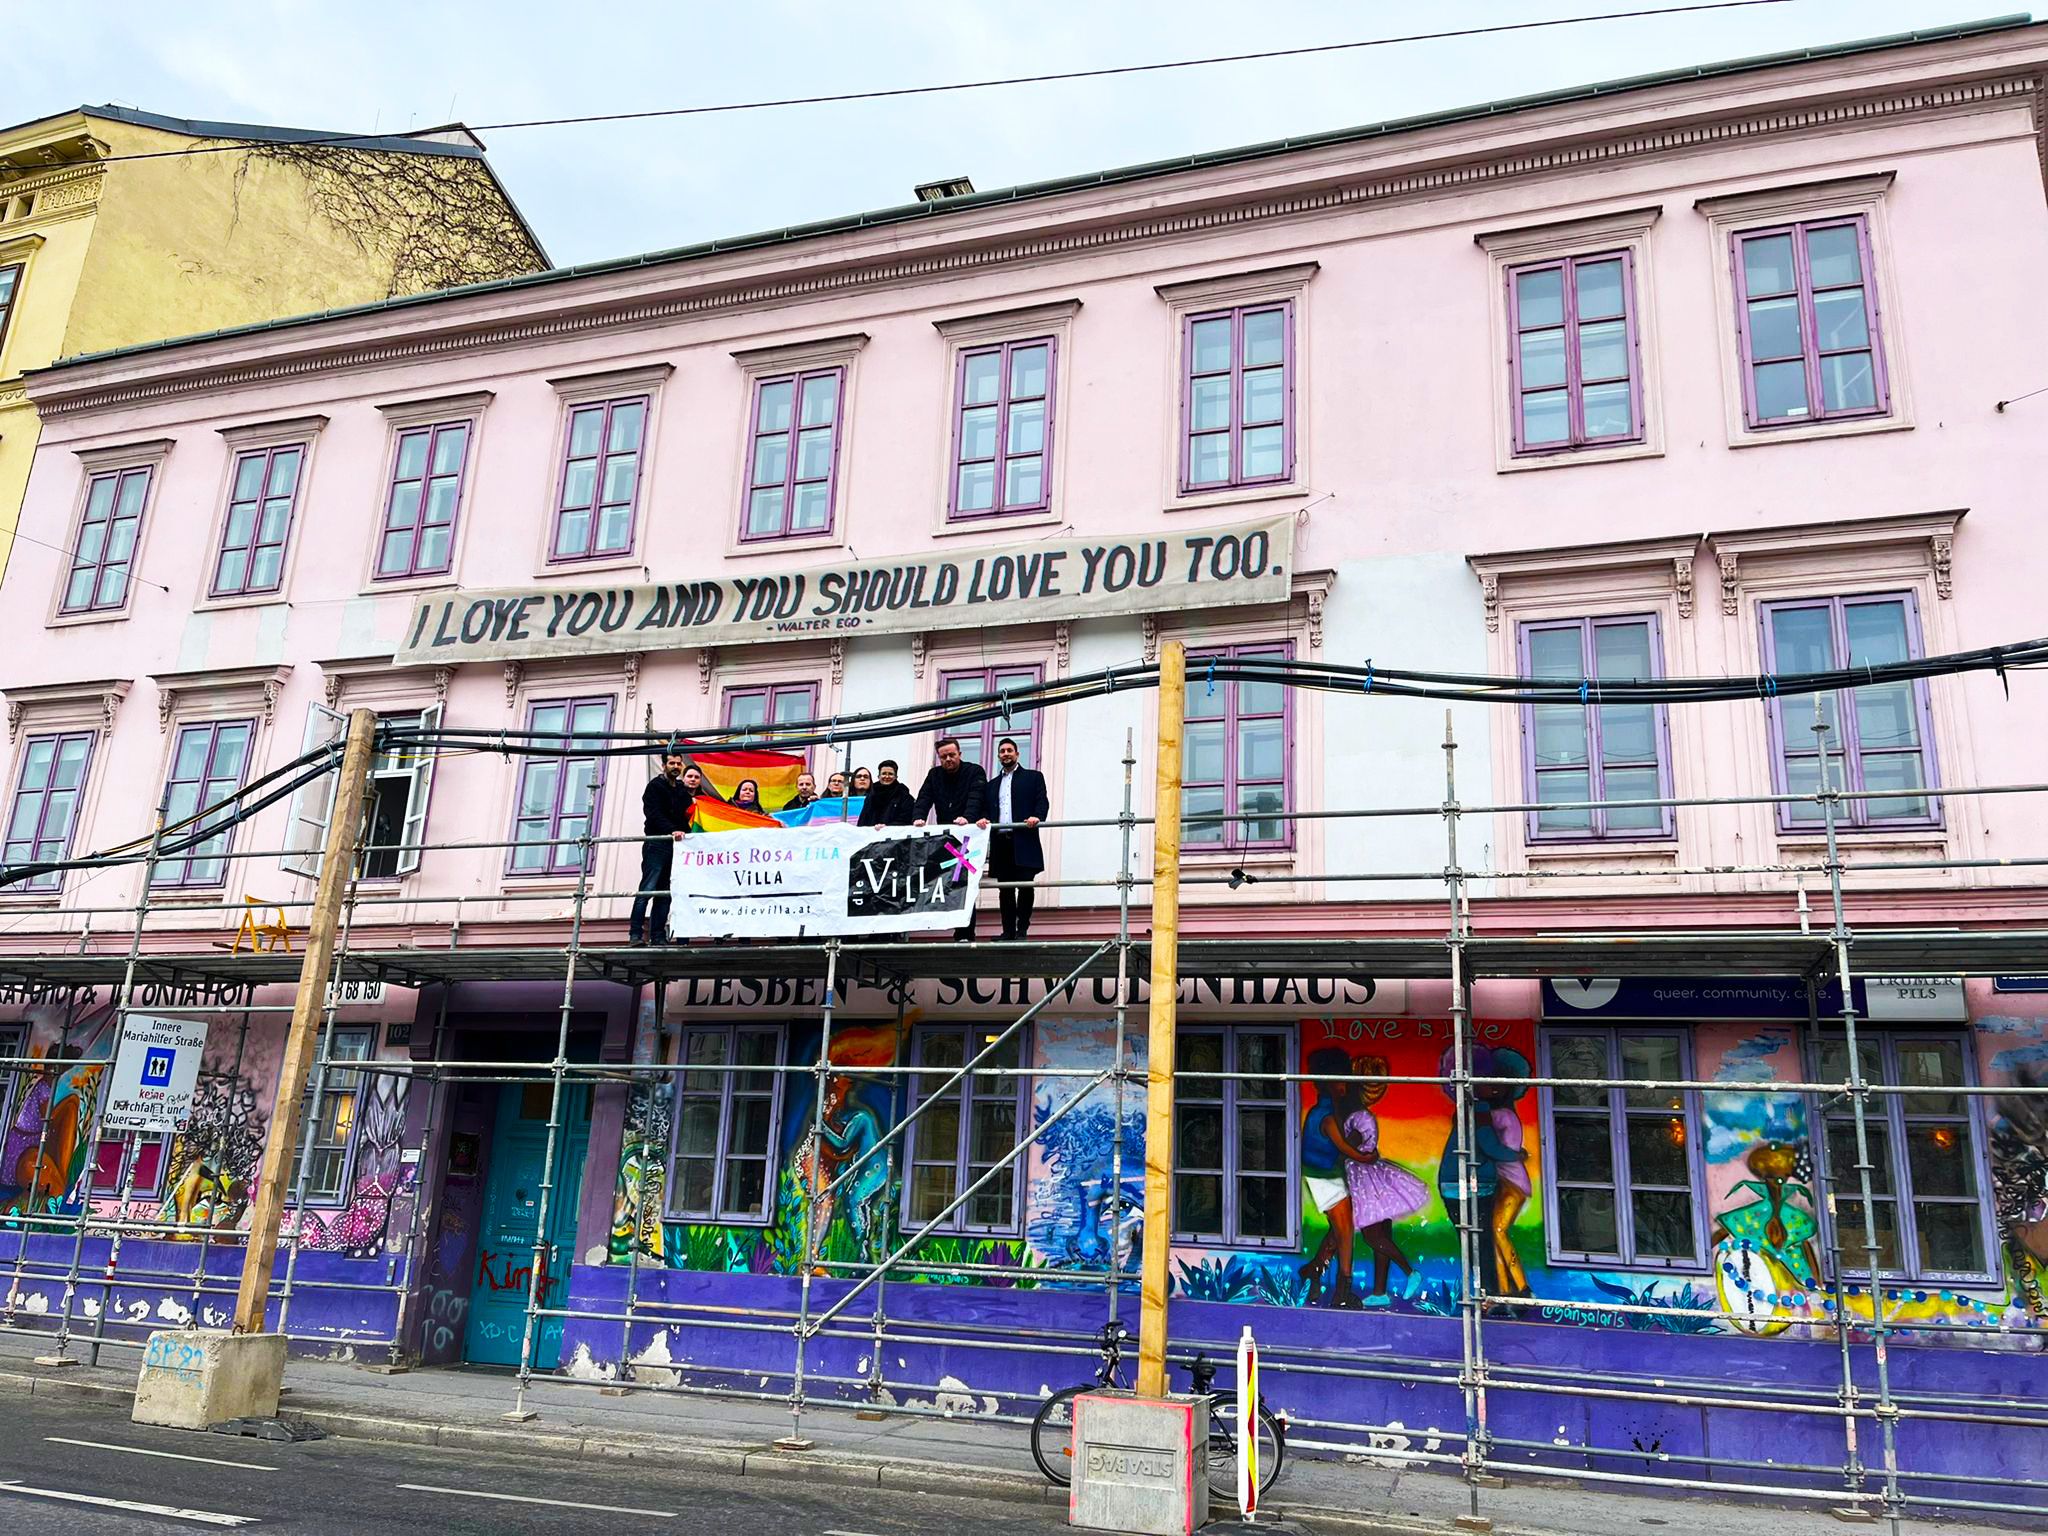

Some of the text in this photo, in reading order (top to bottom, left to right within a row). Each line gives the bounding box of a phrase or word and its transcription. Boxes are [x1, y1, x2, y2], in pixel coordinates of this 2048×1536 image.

[409, 530, 1283, 650] I LOVE YOU AND YOU SHOULD LOVE YOU TOO.
[777, 620, 830, 632] WALTER
[836, 616, 860, 629] EGO
[750, 848, 793, 864] ROSA
[698, 904, 811, 916] www.dievilla.at
[345, 981, 359, 1000] 68
[363, 981, 381, 1000] 150
[936, 977, 1377, 1005] SCHWULNHAUS
[1653, 988, 1832, 1002] queer. community. cae.
[1897, 987, 1938, 1000] PILS
[152, 1020, 182, 1033] Innere
[389, 1025, 410, 1039] 102
[123, 1030, 204, 1048] Mariahilfer Straße
[138, 1088, 165, 1101] keine
[113, 1100, 164, 1114] Drchfaht
[105, 1112, 146, 1128] Querg
[1088, 1452, 1174, 1479] STRABAG
